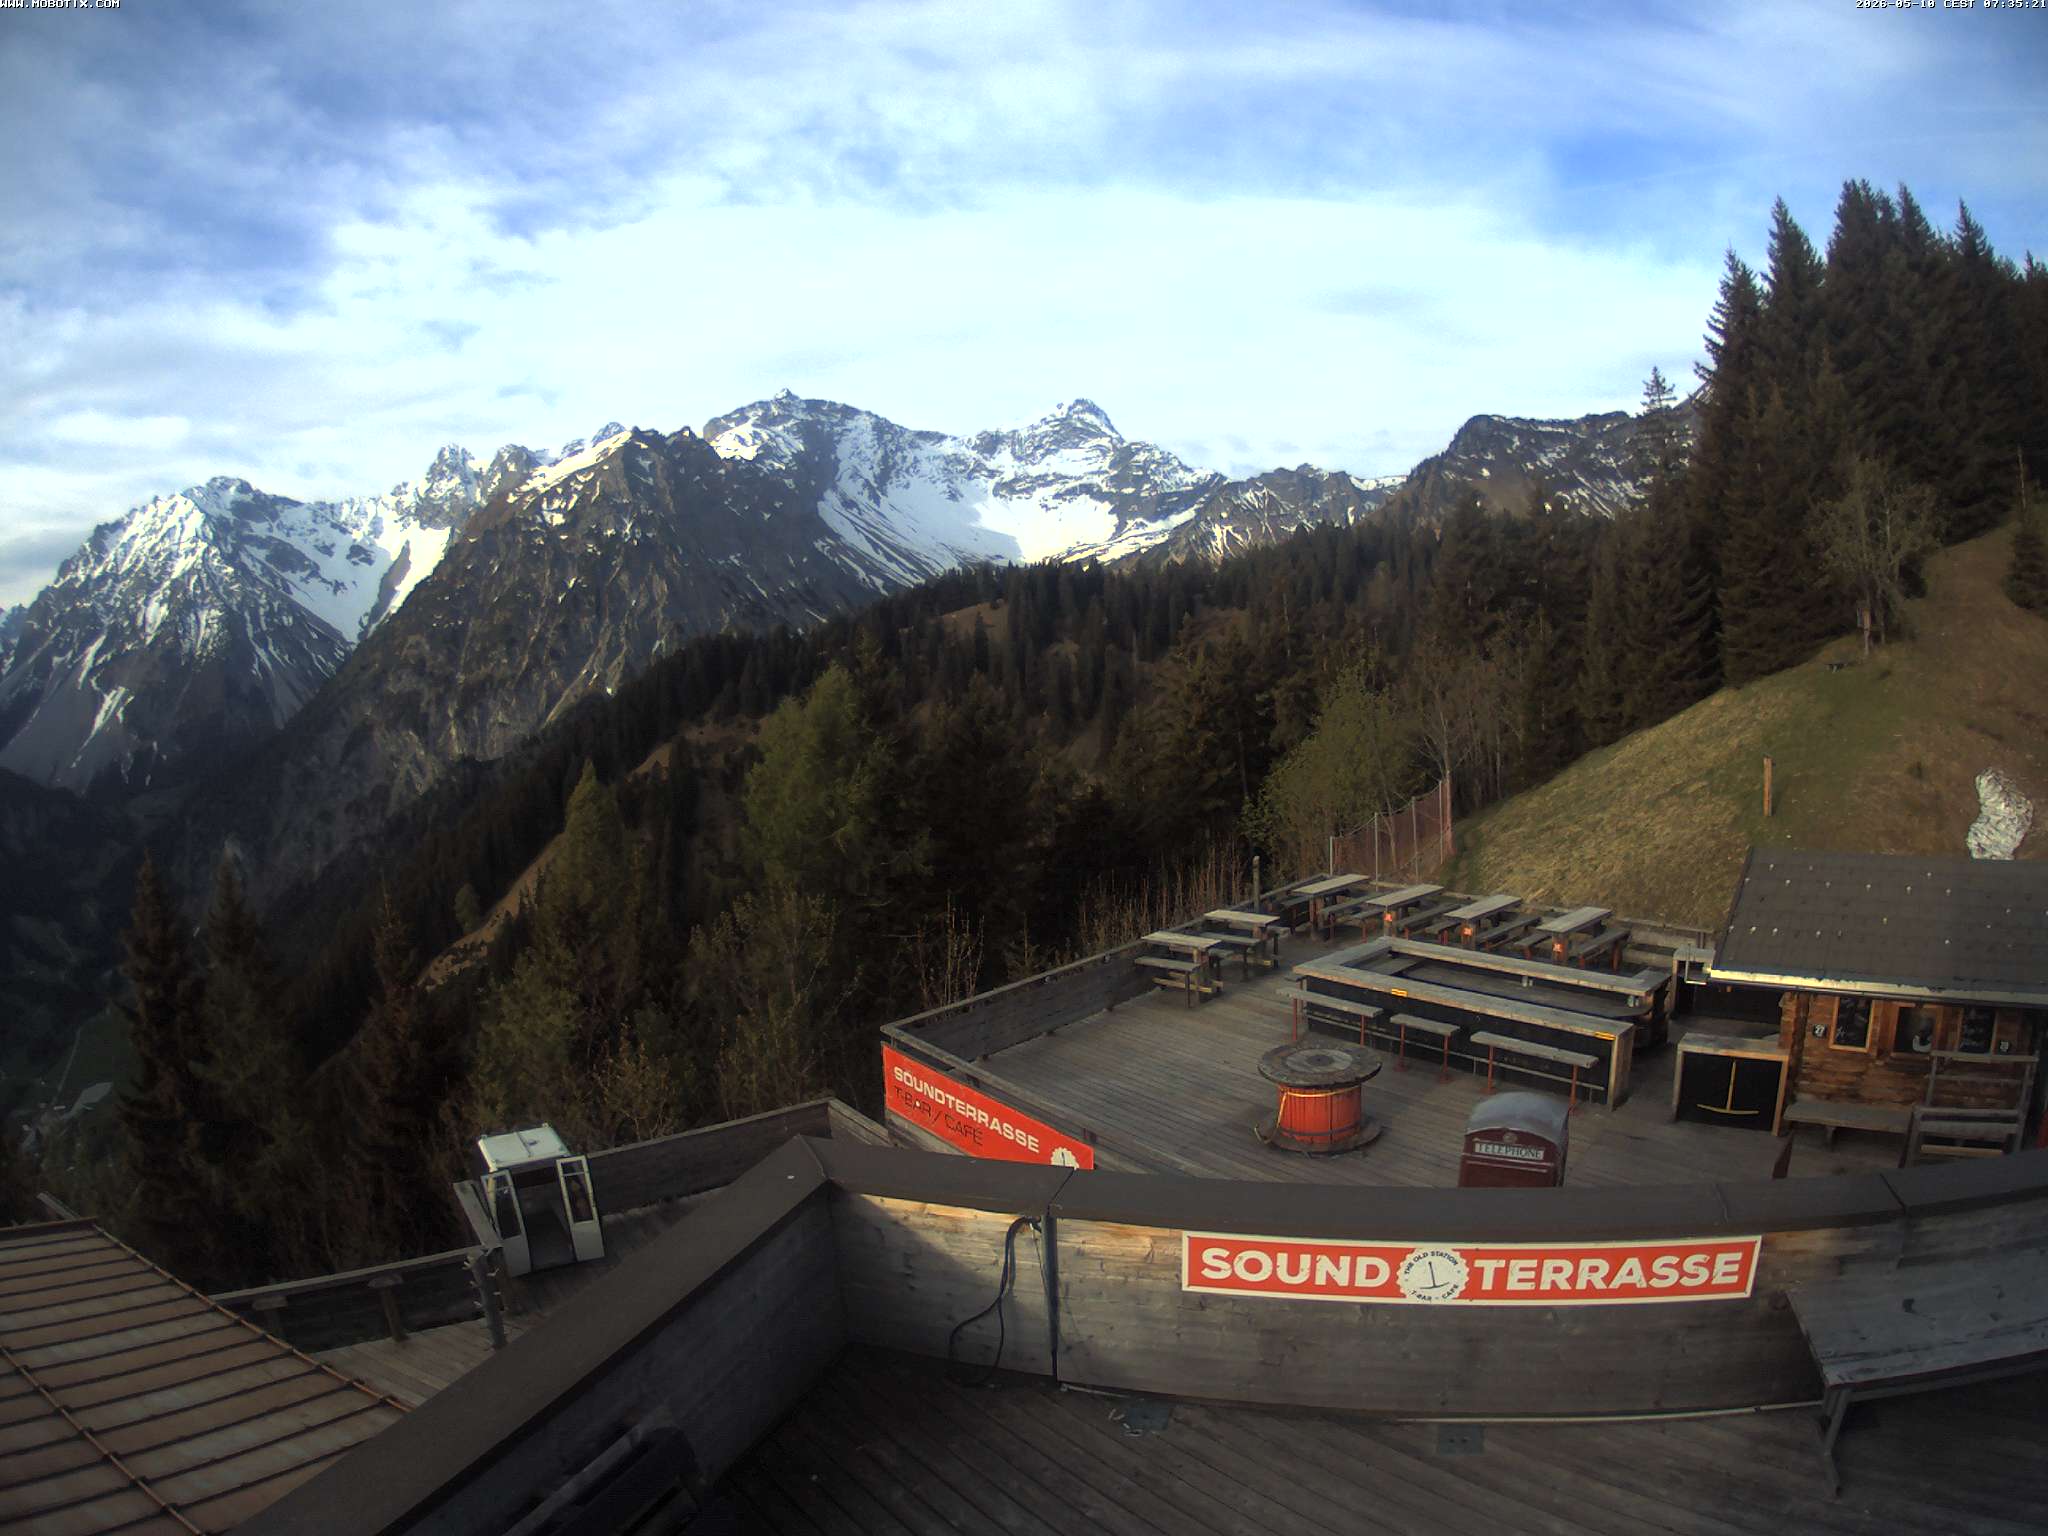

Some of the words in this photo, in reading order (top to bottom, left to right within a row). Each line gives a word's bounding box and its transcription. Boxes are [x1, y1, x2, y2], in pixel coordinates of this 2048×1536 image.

[893, 1066, 1040, 1153] SOUNDTERRASSE
[1477, 1142, 1541, 1160] TELEPHONE
[1200, 1247, 1391, 1288] SOUND
[1474, 1252, 1743, 1291] TERRASSE
[1404, 1262, 1415, 1275] THE
[1413, 1252, 1428, 1263] OLD
[1431, 1250, 1459, 1266] STATION
